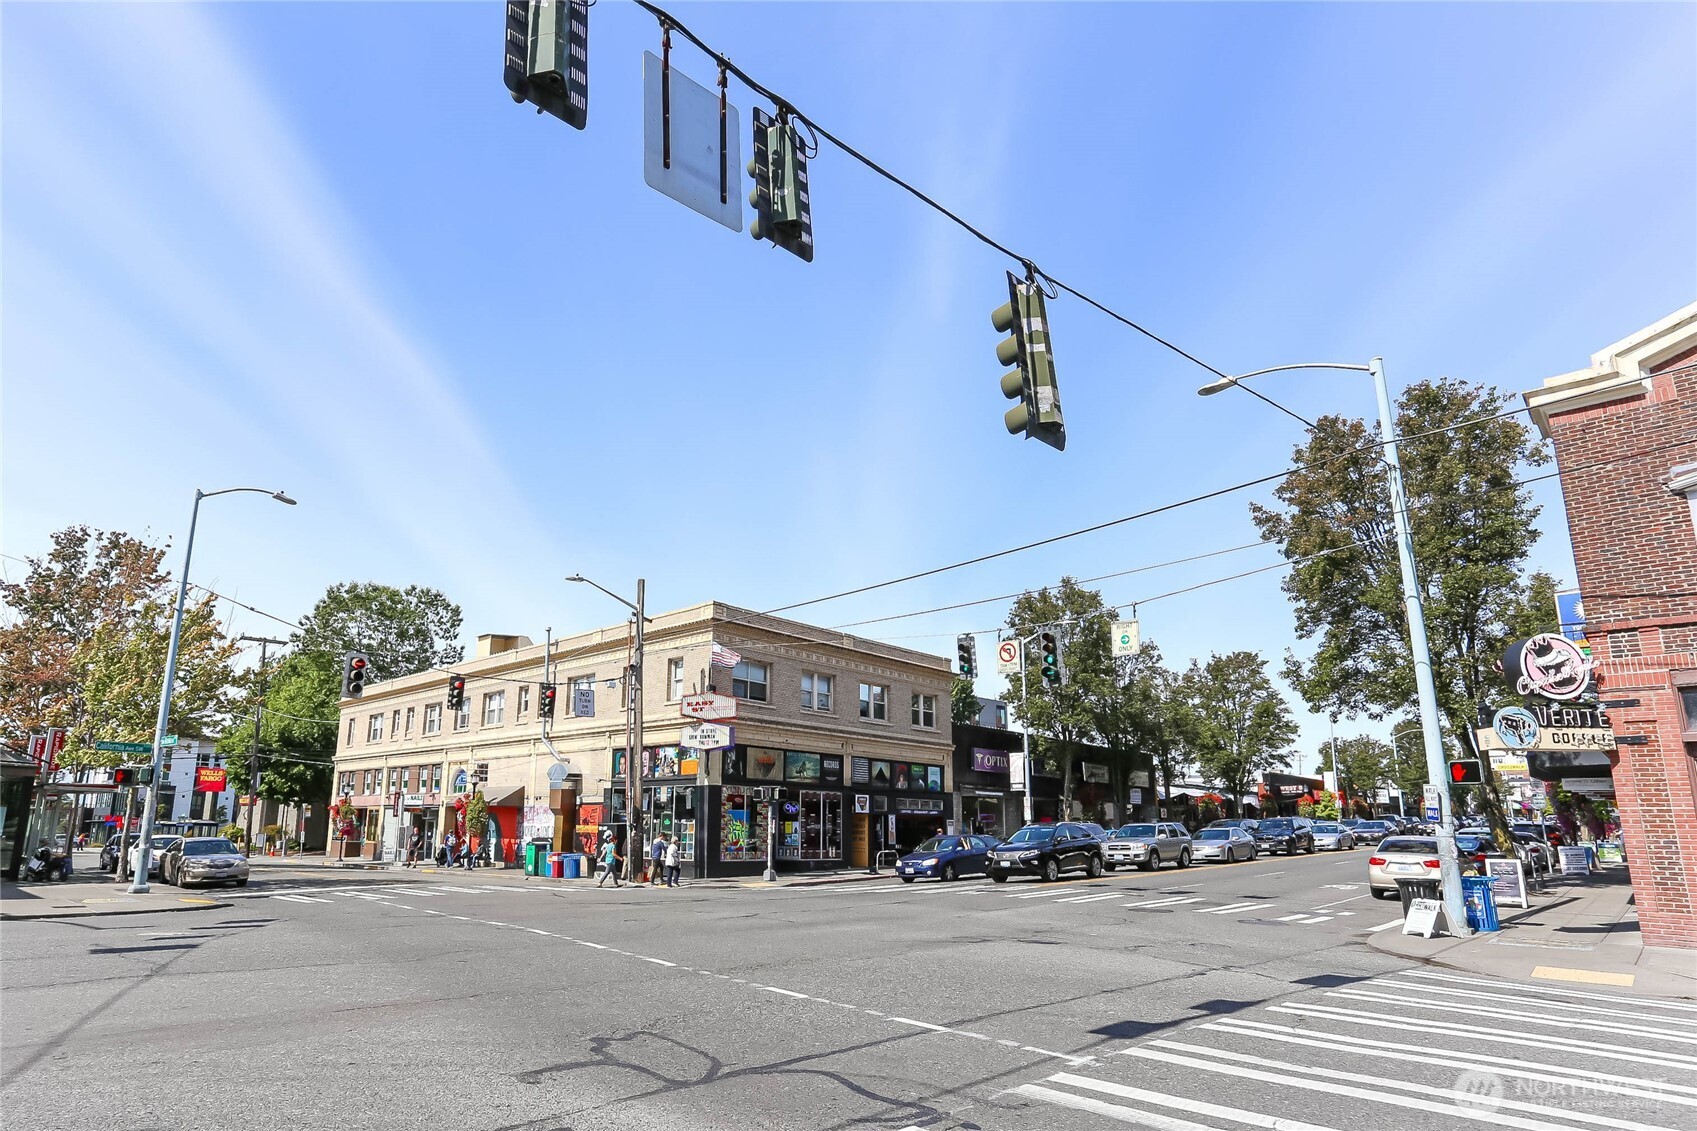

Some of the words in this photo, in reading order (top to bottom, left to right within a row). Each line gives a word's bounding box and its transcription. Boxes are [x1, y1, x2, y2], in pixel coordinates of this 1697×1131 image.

[1116, 623, 1133, 631] RIGHT
[1118, 645, 1134, 653] ONLY
[686, 700, 714, 708] EASY
[1531, 705, 1610, 727] VERITE
[96, 742, 125, 750] California
[983, 754, 1008, 769] OPTIX
